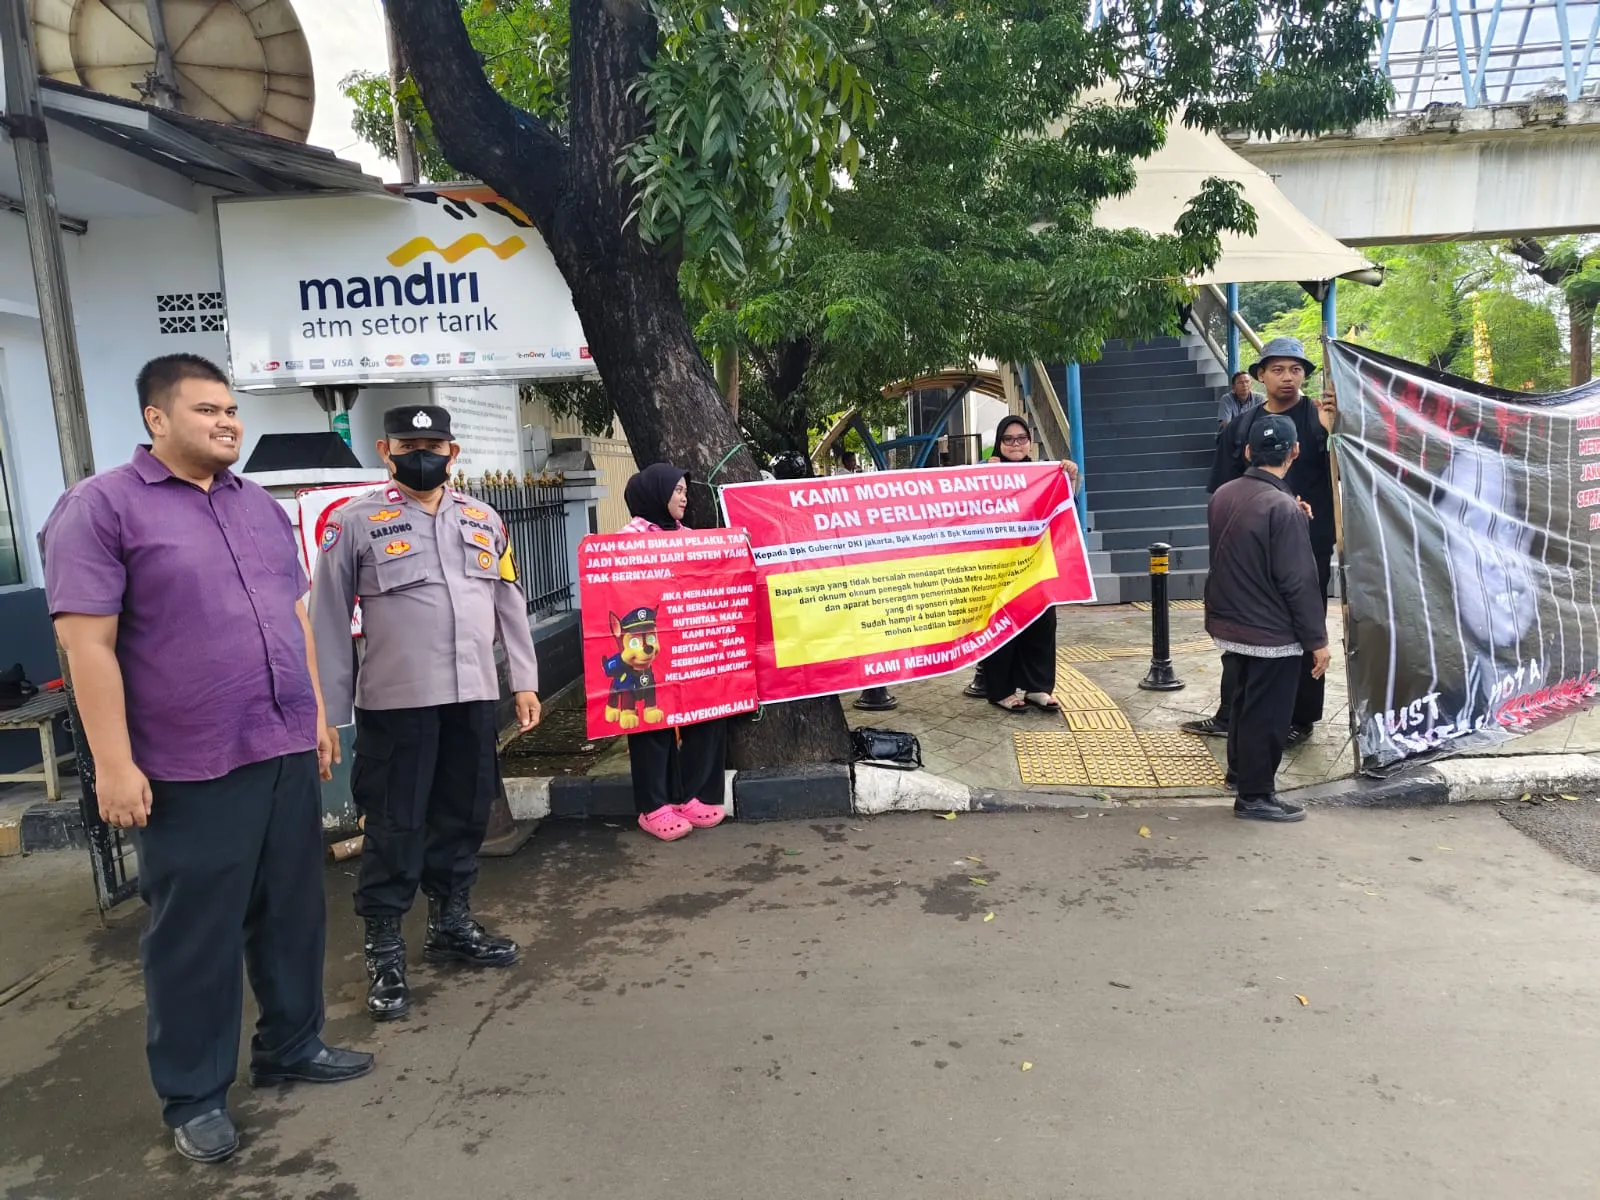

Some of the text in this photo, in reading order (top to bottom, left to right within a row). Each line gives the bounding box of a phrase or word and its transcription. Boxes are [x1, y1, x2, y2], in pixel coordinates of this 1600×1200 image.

[299, 262, 480, 311] mandiri
[302, 307, 499, 339] atm setor tarik
[331, 358, 354, 367] VISA
[789, 473, 1027, 508] KAMI MOHON BANTUAN
[813, 498, 1020, 531] DAN PERLINDUNGAN
[370, 523, 413, 539] SARJONO
[584, 541, 616, 553] AYAH
[617, 539, 646, 551] KAMI
[647, 537, 683, 549] BUKAN
[754, 549, 788, 560] Kepada
[789, 546, 807, 556] Bpk
[808, 542, 846, 553] Gubernur
[848, 540, 863, 548] DKI
[896, 534, 911, 544] Bpk
[912, 531, 938, 542] Kapolri
[947, 529, 961, 539] Bpk
[962, 527, 986, 536] Komisi
[586, 548, 748, 568] JADI KORBAN DARI SISTEM YANG
[585, 567, 675, 584] TAK BERNYAWA.
[775, 586, 803, 597] Bapak
[805, 584, 826, 595] saya
[826, 580, 848, 591] yang
[849, 578, 871, 587] tidak
[871, 572, 907, 584] bersalah
[908, 568, 945, 580] mendapat
[946, 565, 977, 574] tindakan
[661, 584, 753, 602] JIKA MENAHAN ORANG
[799, 595, 816, 605] dari
[818, 591, 847, 602] oknum
[848, 587, 877, 598] oknum
[878, 582, 912, 595] penegak
[913, 579, 939, 590] hukum
[965, 574, 983, 583] Metro
[824, 587, 970, 612] dan aparat berseragam pemerintahan
[666, 597, 749, 614] TAK BERSALAH JADI
[885, 606, 904, 616] yang
[906, 602, 914, 611] di
[916, 599, 948, 611] sponsori
[949, 596, 968, 606] pihak
[719, 611, 744, 621] MAKA
[860, 619, 887, 629] Sudah
[888, 613, 916, 625] hampir
[925, 609, 946, 619] bulan
[947, 607, 967, 617] bapak
[682, 625, 737, 640] KAMI PANTAS
[884, 627, 912, 637] mohon
[913, 620, 946, 632] keadilan
[671, 648, 747, 668] SEBENARNYA YANG
[864, 658, 900, 676] KAMI
[665, 666, 716, 682] MELANGGAR
[666, 698, 755, 725] #SAVEKONGJALI
